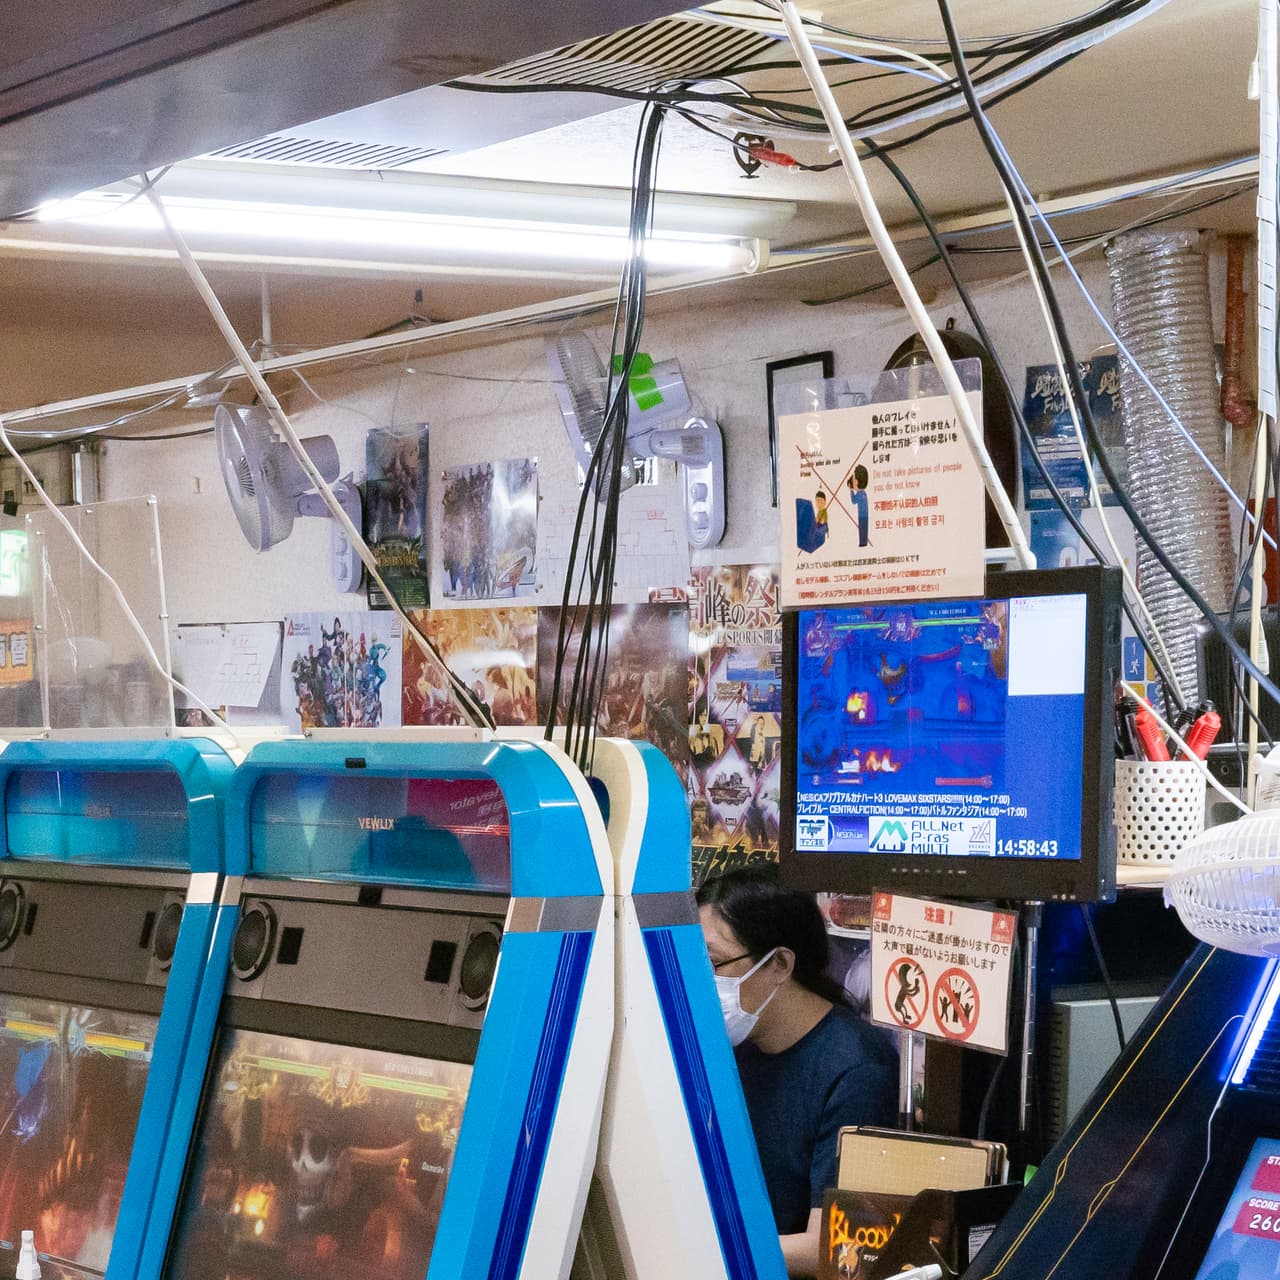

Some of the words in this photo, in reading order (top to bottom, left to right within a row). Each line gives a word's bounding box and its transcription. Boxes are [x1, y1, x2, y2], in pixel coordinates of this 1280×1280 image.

[884, 794, 917, 804] LOVEMAX
[797, 805, 828, 814] ブレイブルー
[358, 815, 394, 831] VEWLIX
[911, 820, 964, 832] ALL.Net
[911, 832, 950, 843] P-ras
[911, 843, 949, 855] MULTI
[997, 839, 1058, 857] 14:58:43
[923, 906, 954, 927] 注意！
[883, 940, 997, 971] 大声で騒がないようお願いします
[1248, 1198, 1280, 1211] SCORE
